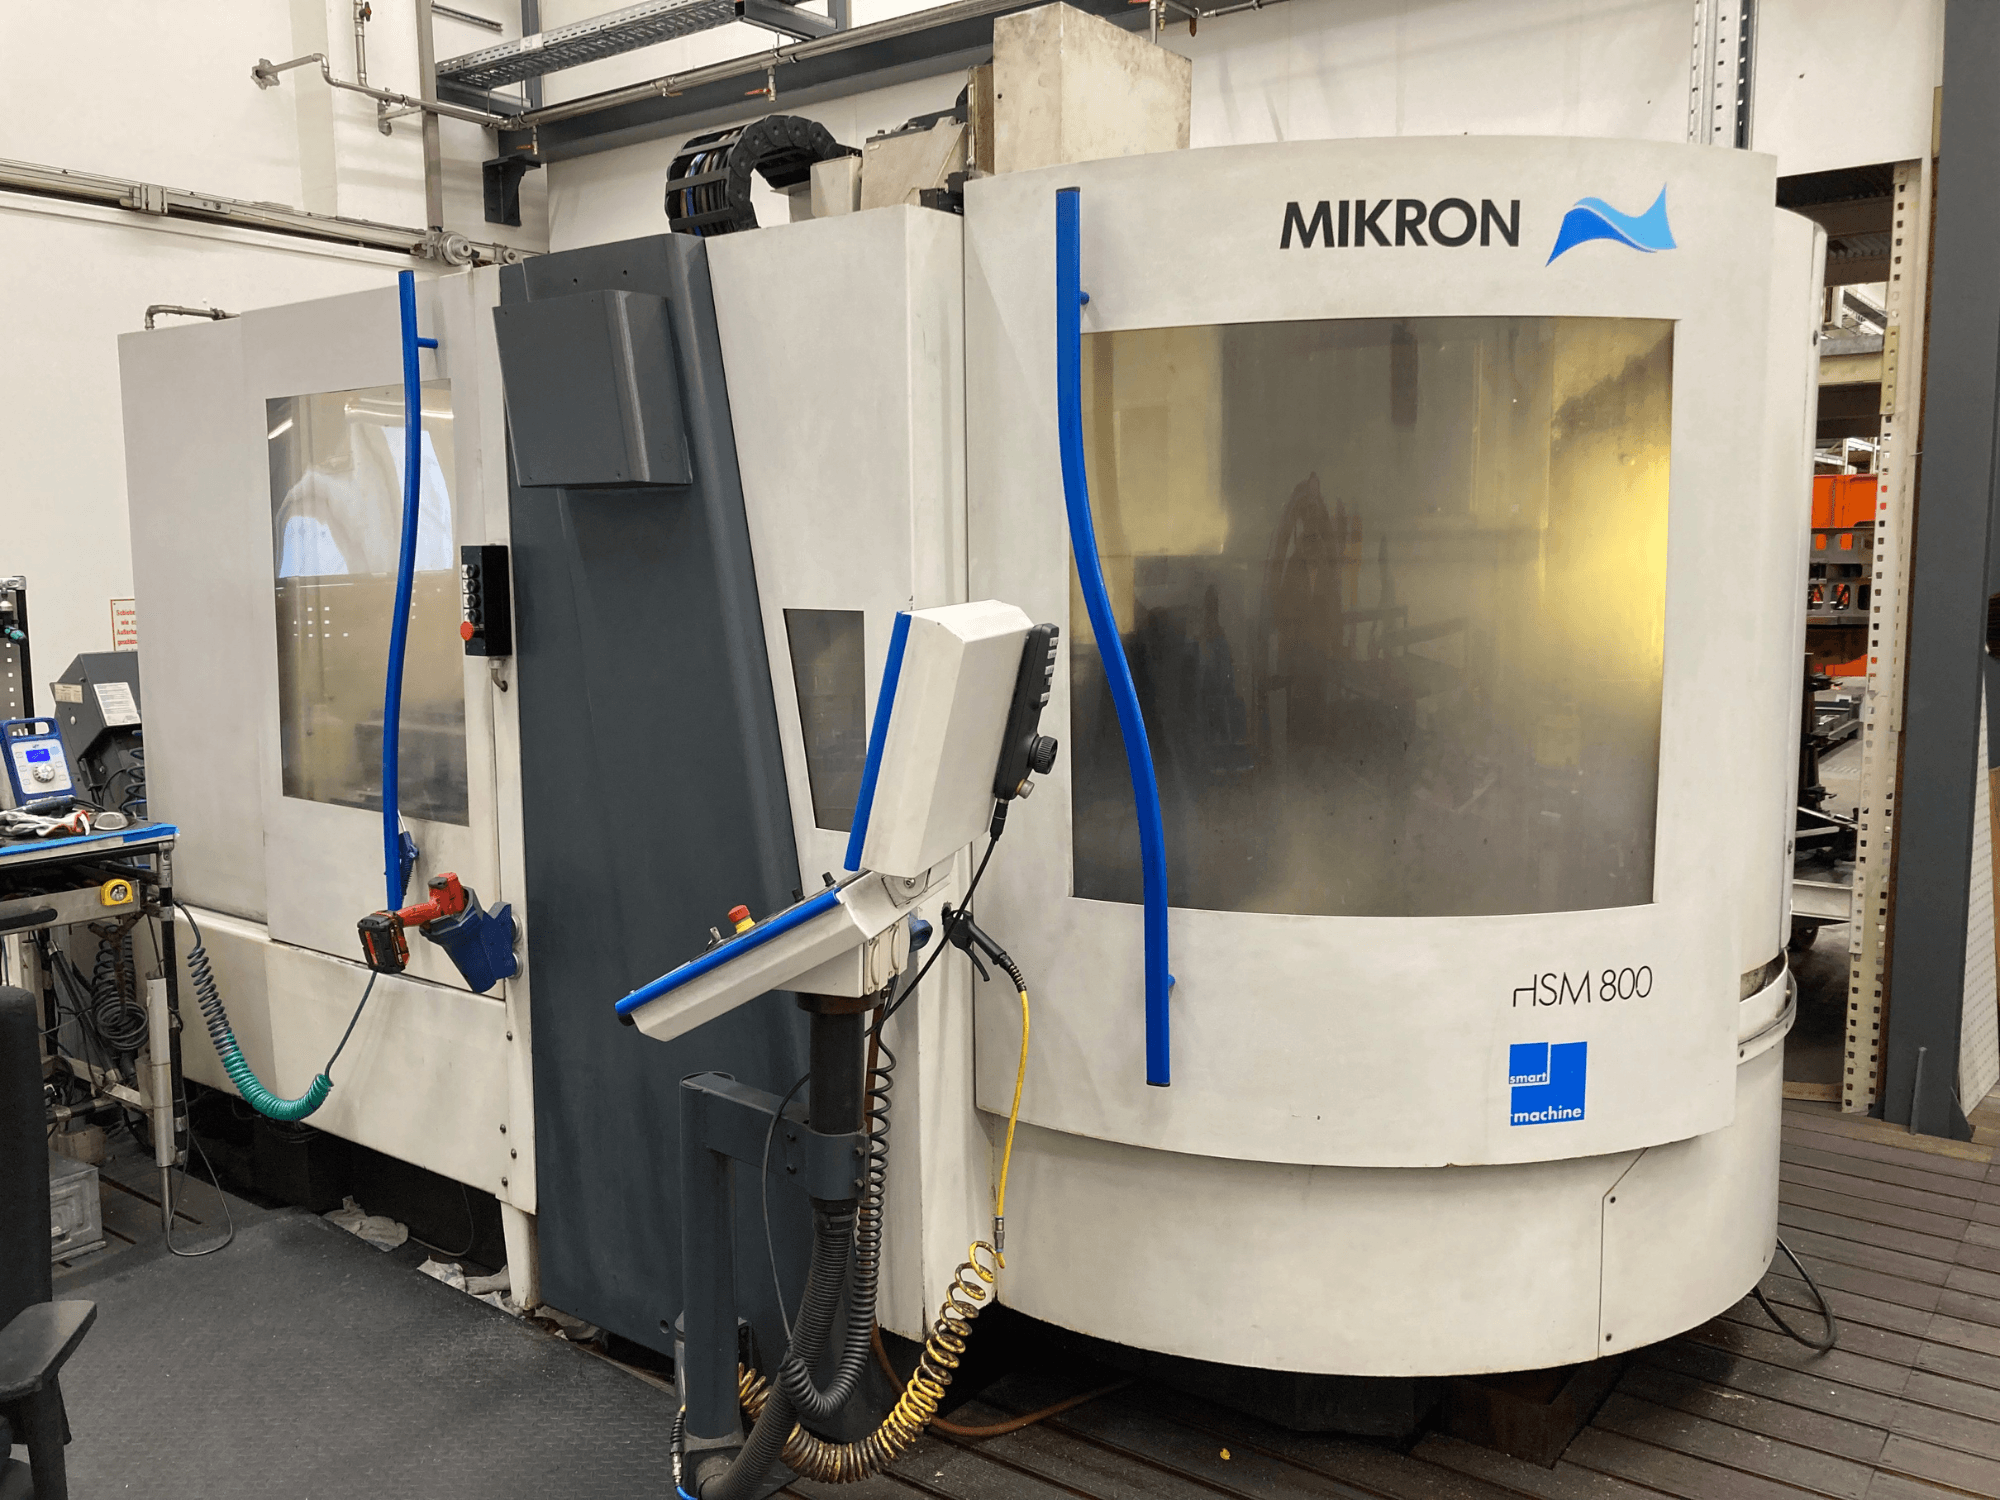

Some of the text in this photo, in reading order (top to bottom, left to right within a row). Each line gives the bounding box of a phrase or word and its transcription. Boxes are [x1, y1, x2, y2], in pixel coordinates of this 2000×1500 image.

[1280, 197, 1521, 249] MIKRON
[1513, 965, 1653, 1007] HSM 800
[1509, 1072, 1547, 1084] smart
[1514, 1105, 1582, 1123] machine
